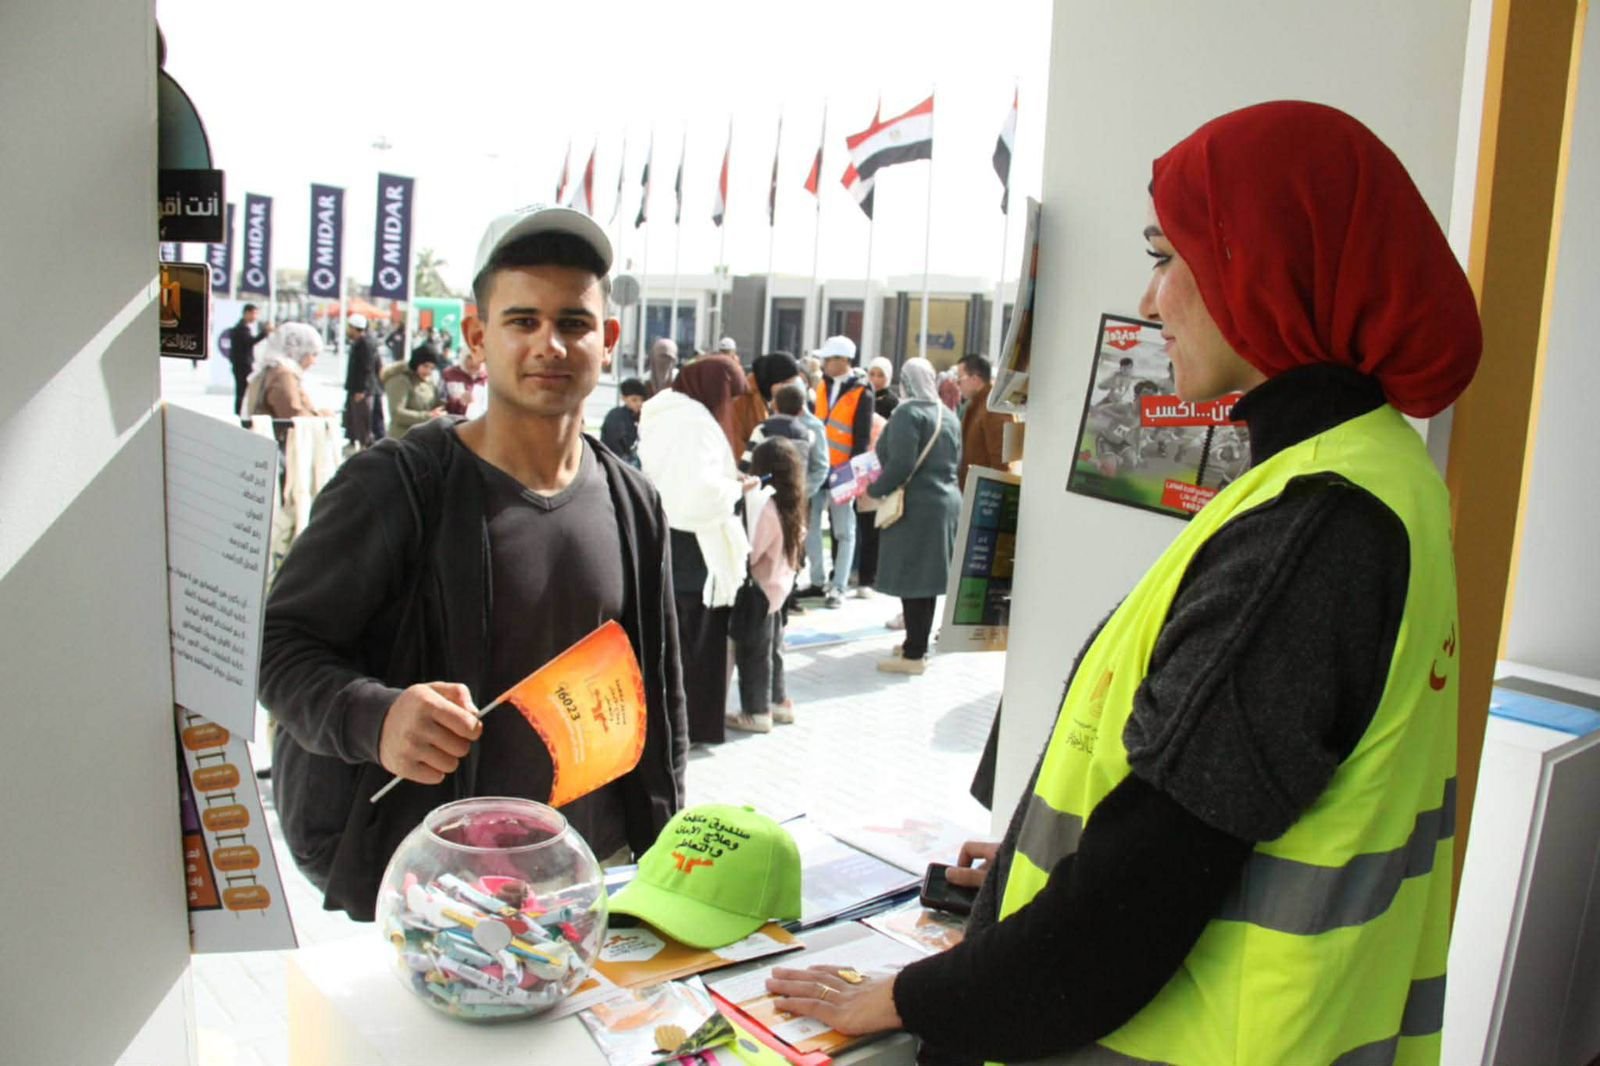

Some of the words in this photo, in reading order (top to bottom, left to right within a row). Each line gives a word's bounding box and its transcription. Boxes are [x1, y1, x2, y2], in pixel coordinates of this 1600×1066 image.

[185, 192, 219, 216] أنت
[382, 185, 404, 265] MIDAR
[248, 203, 266, 267] MIDAR
[317, 195, 336, 266] MIDAR
[554, 686, 581, 722] 16023
[708, 817, 751, 840] صندوق
